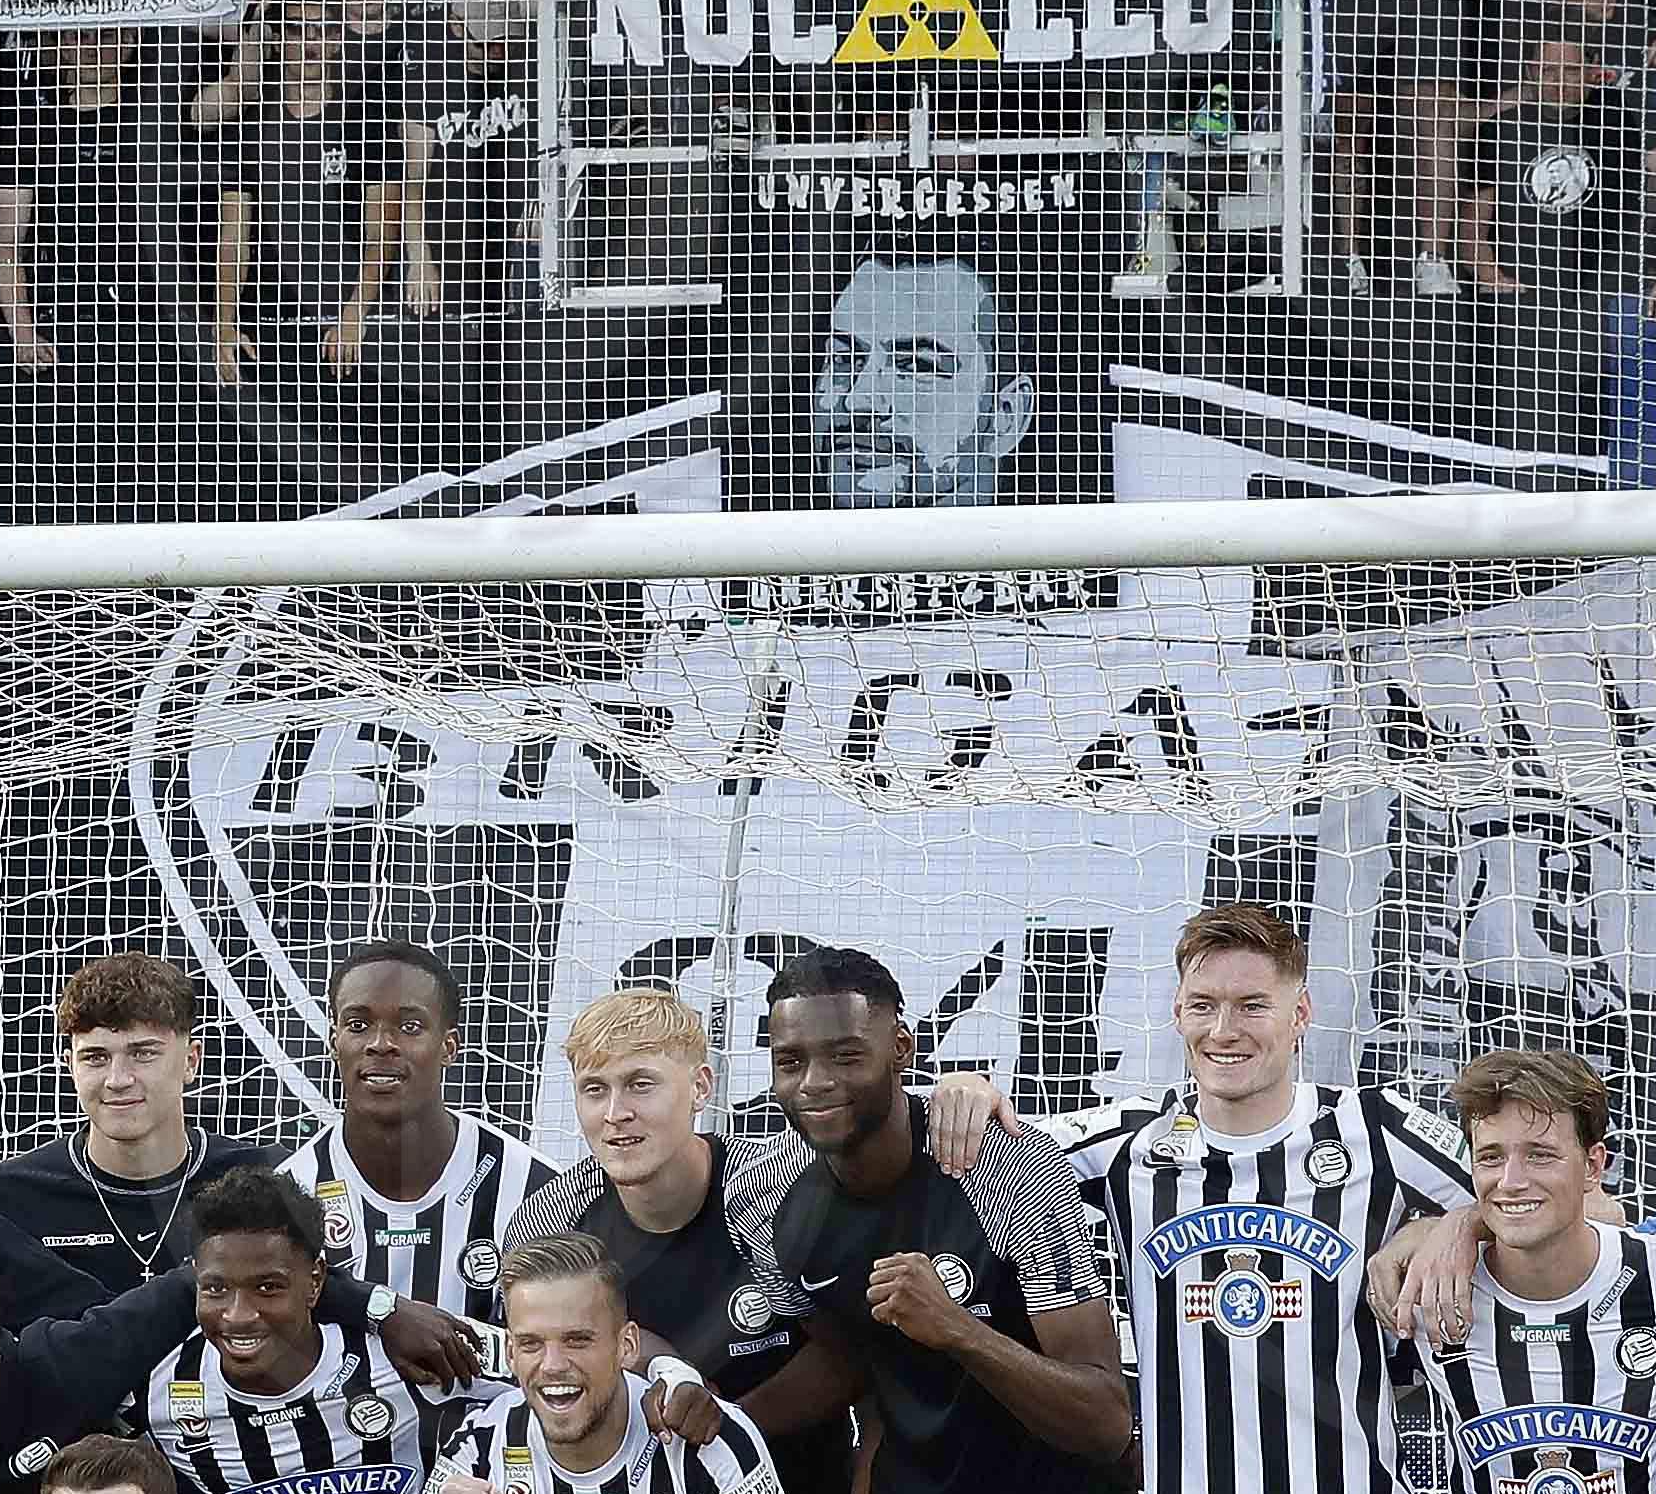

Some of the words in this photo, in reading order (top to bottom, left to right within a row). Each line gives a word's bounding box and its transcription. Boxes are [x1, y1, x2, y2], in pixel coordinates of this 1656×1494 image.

[755, 170, 1076, 216] UNVERGESSEN
[390, 1233, 431, 1247] GRAWE
[1153, 1210, 1346, 1271] PUNTIGAMER
[1526, 1329, 1572, 1344] GRAWE
[264, 1407, 308, 1426] GRAWE
[1461, 1406, 1652, 1463] PUNTIGAMER
